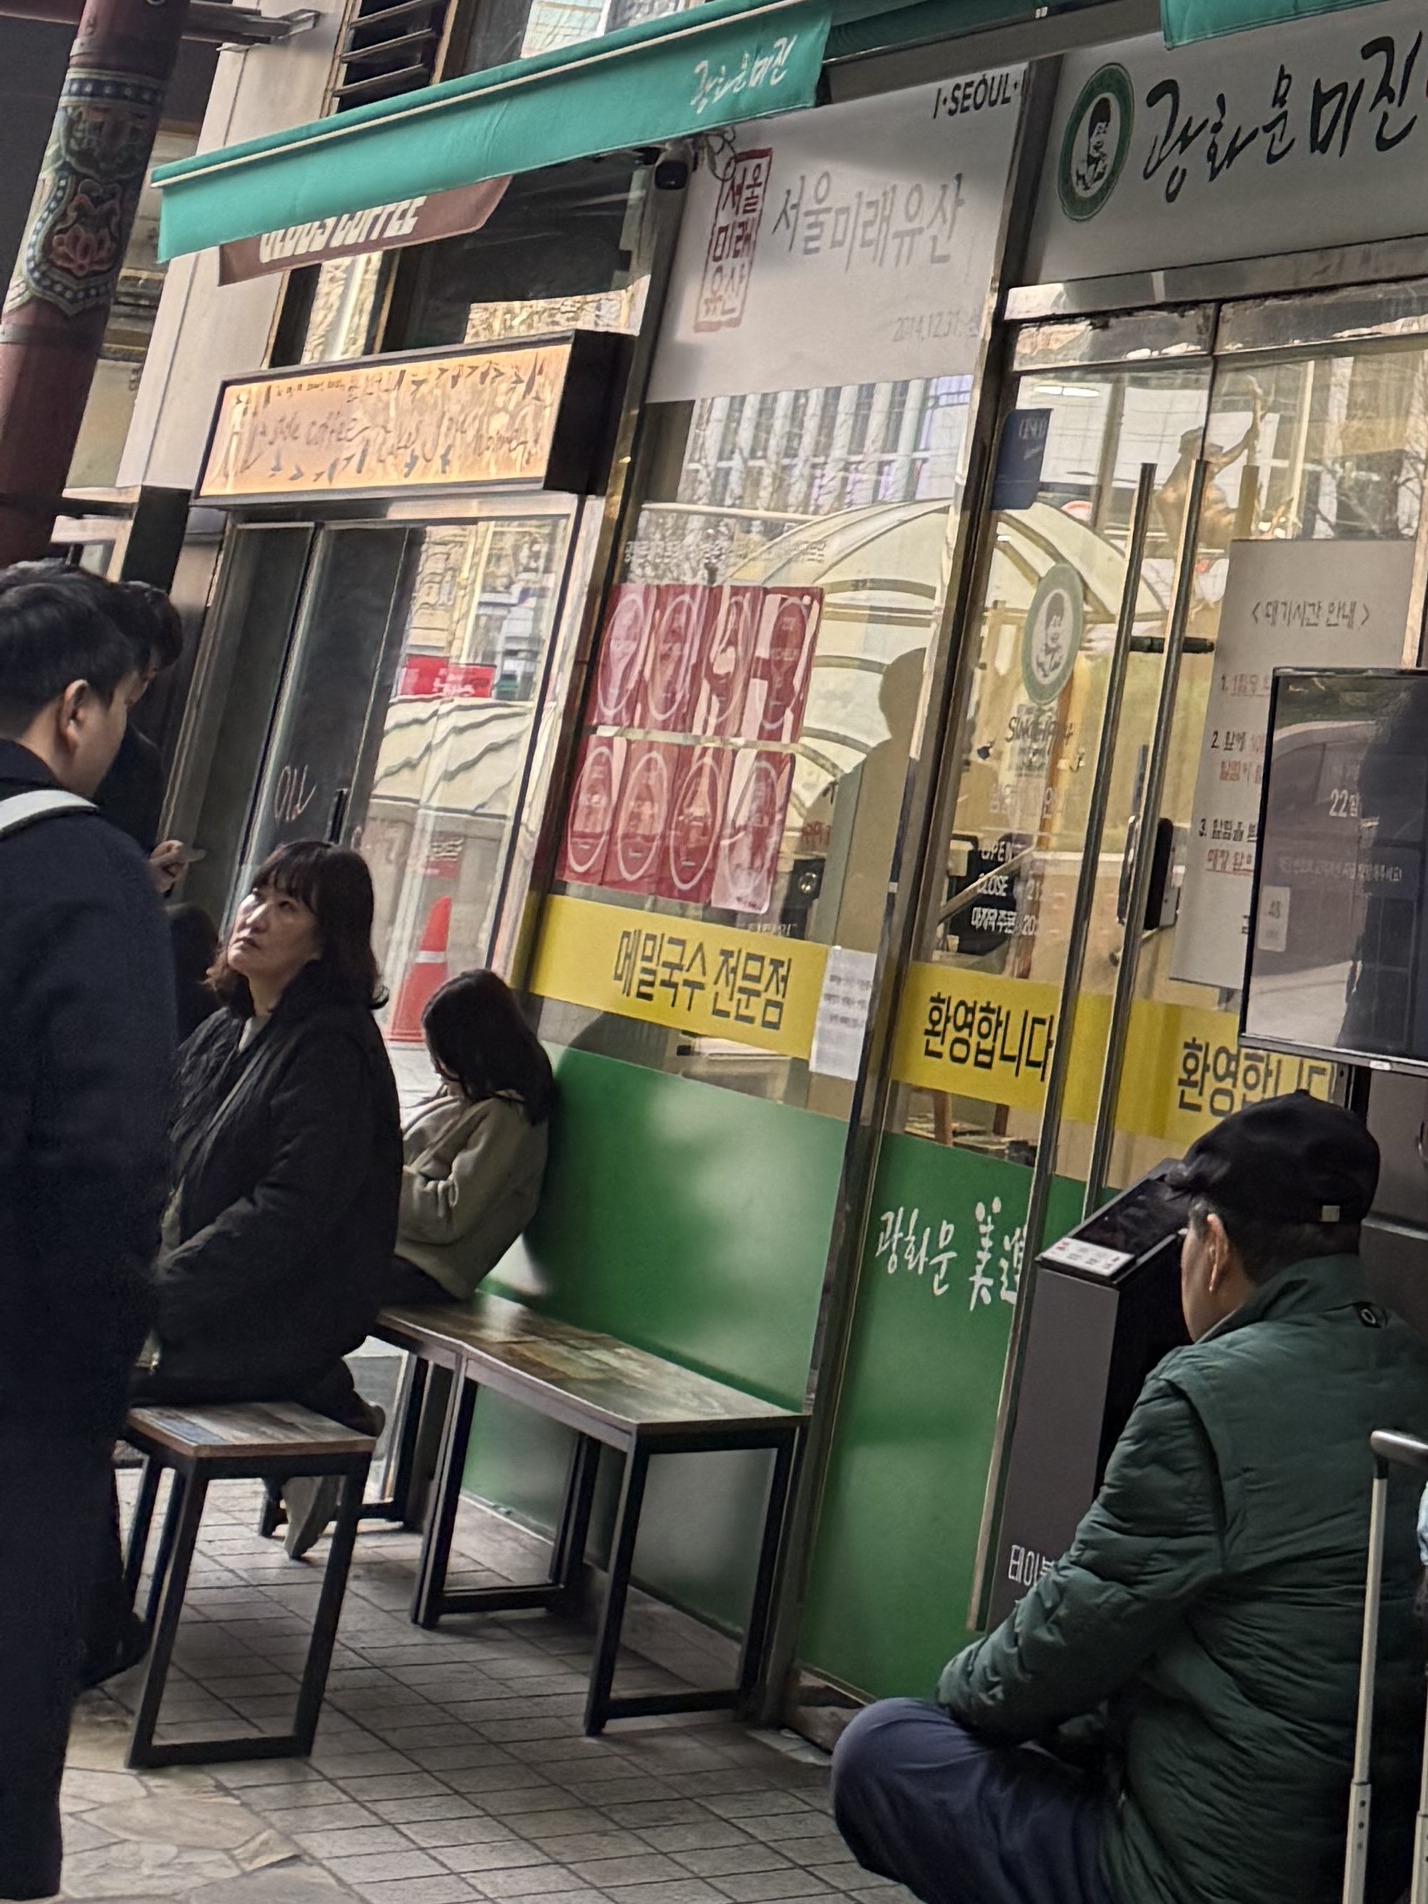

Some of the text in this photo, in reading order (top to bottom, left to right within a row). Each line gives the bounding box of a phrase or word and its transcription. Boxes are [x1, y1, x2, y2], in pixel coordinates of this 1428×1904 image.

[772, 170, 966, 273] 서울미래유산
[613, 928, 707, 1012] 메밀국수
[712, 947, 793, 1032] 전문점
[924, 992, 1055, 1082] 환영합니다
[875, 1207, 959, 1296] 광화문
